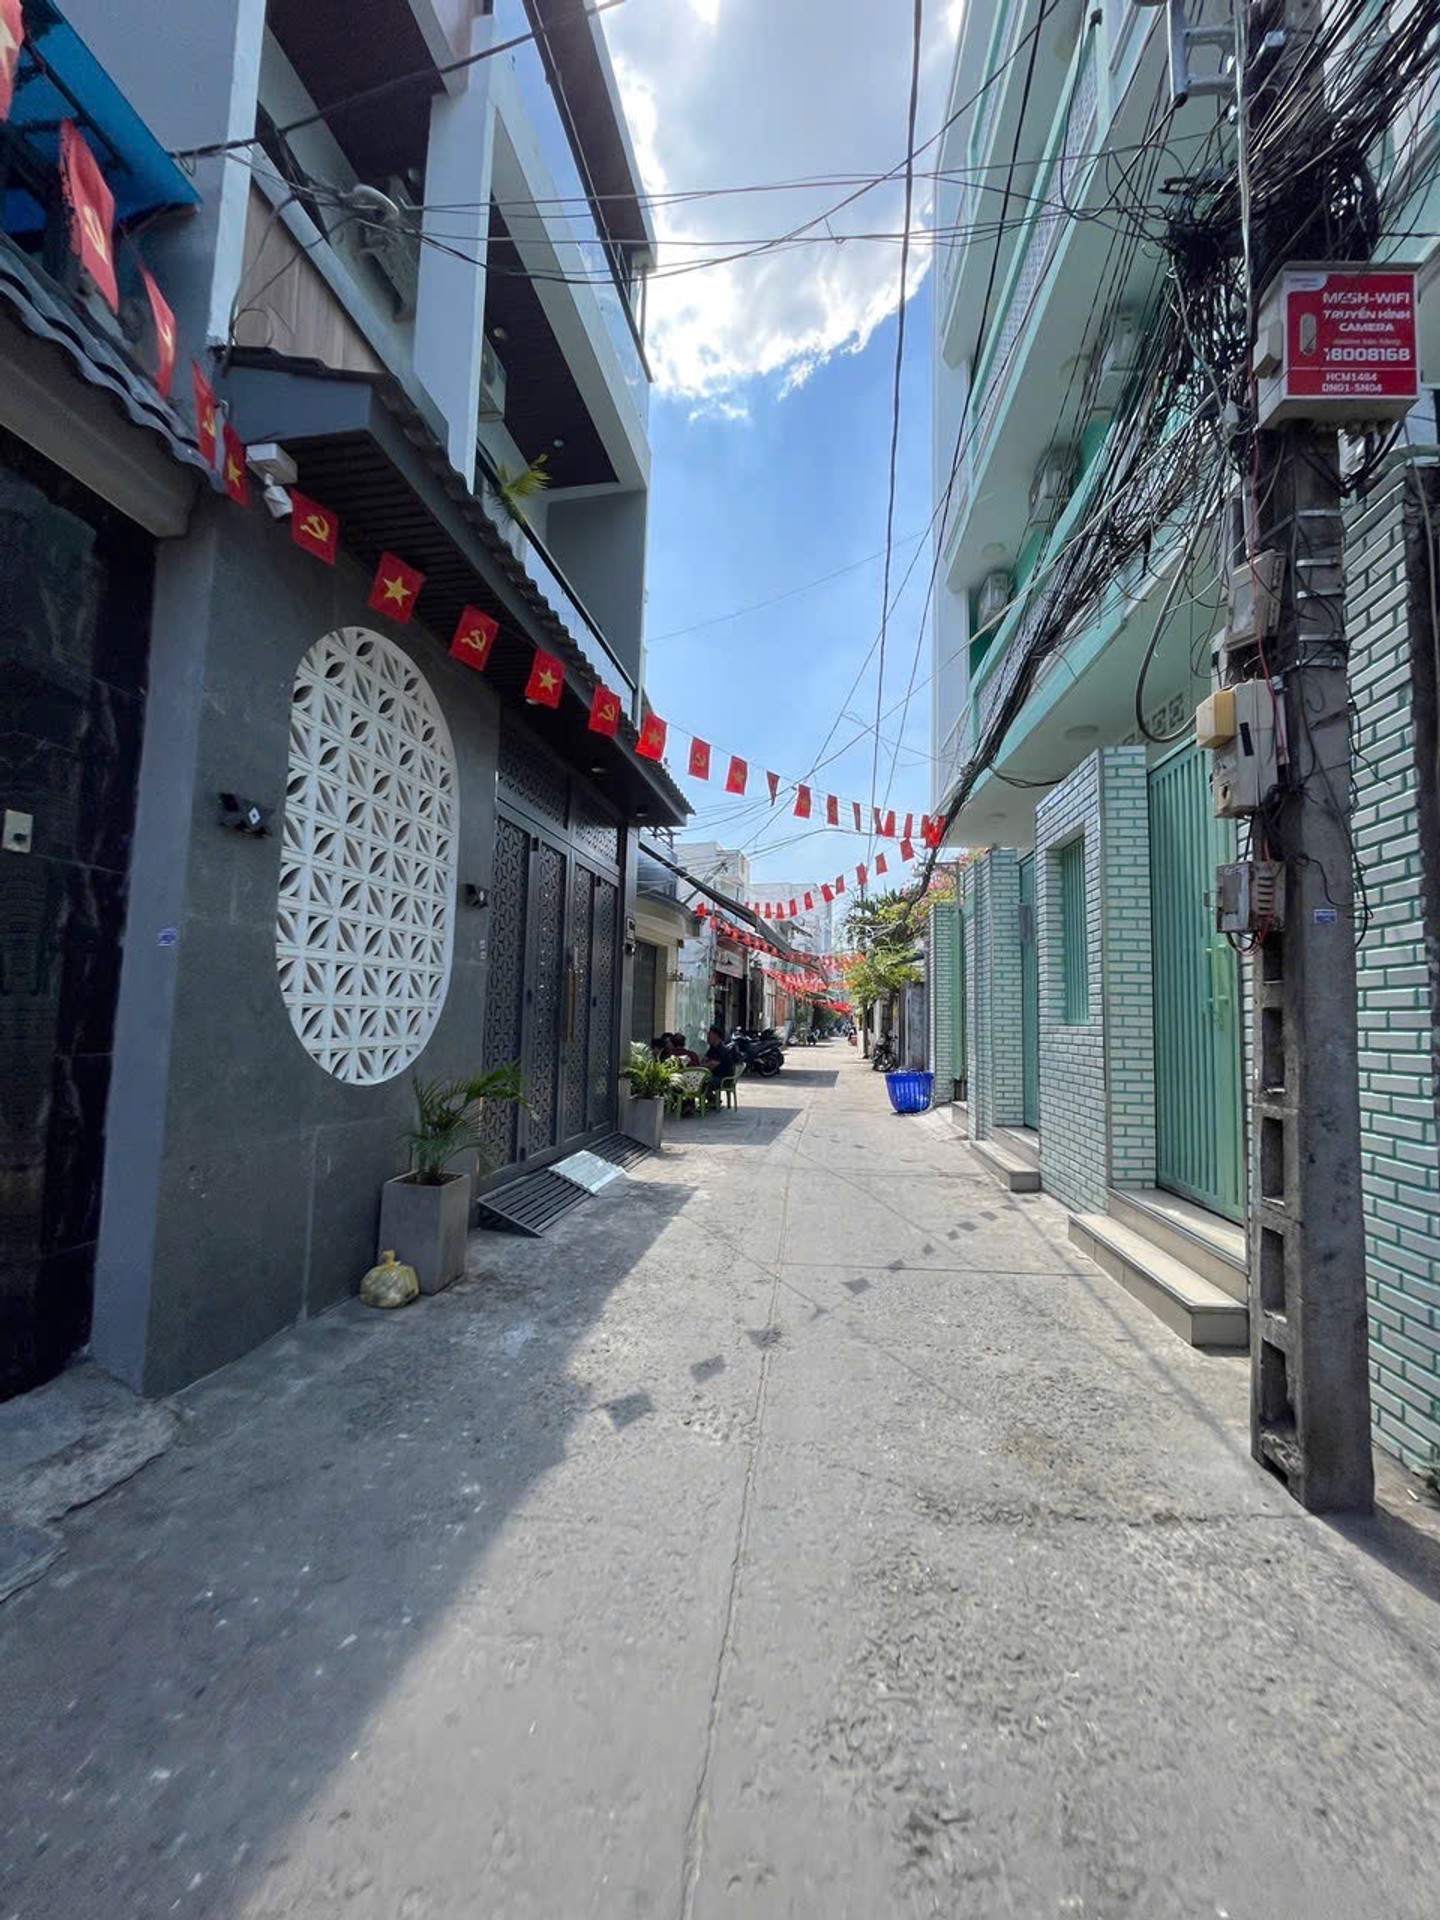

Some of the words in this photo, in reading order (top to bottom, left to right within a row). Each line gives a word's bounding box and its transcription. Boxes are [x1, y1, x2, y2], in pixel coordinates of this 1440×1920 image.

[1322, 292, 1410, 304] MESH-WIFI
[1339, 322, 1394, 332] CAMERA
[1323, 347, 1410, 361] 18008168
